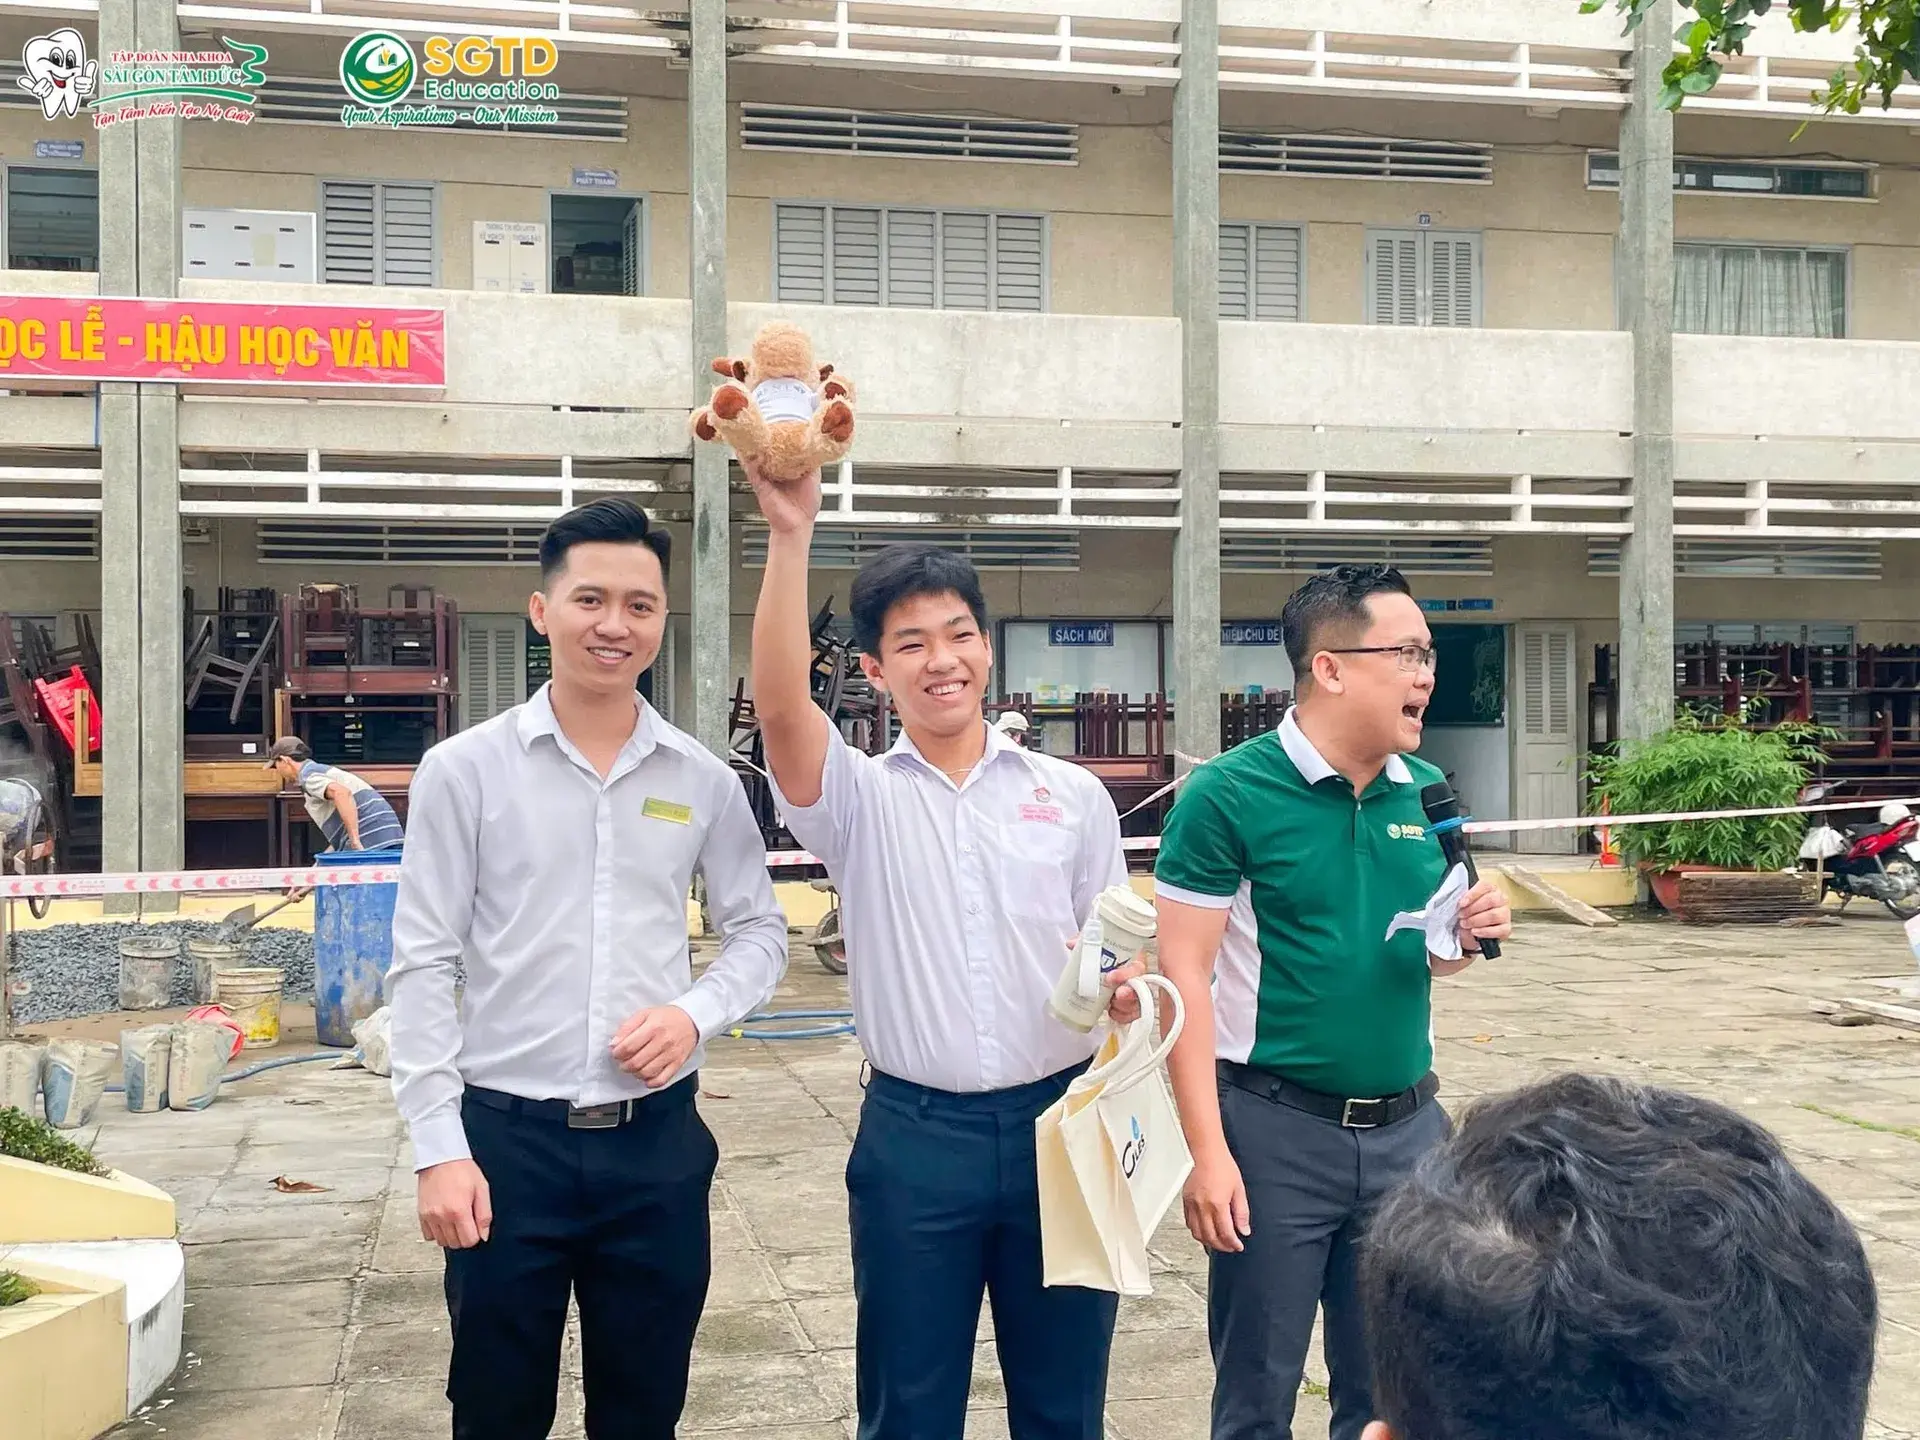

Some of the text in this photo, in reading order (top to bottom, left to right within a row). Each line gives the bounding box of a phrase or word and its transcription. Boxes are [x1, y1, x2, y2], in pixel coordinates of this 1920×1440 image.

[59, 305, 105, 361] LỄ
[145, 314, 228, 371] HẬU
[240, 325, 319, 375] HỌC
[329, 318, 410, 369] VĂN
